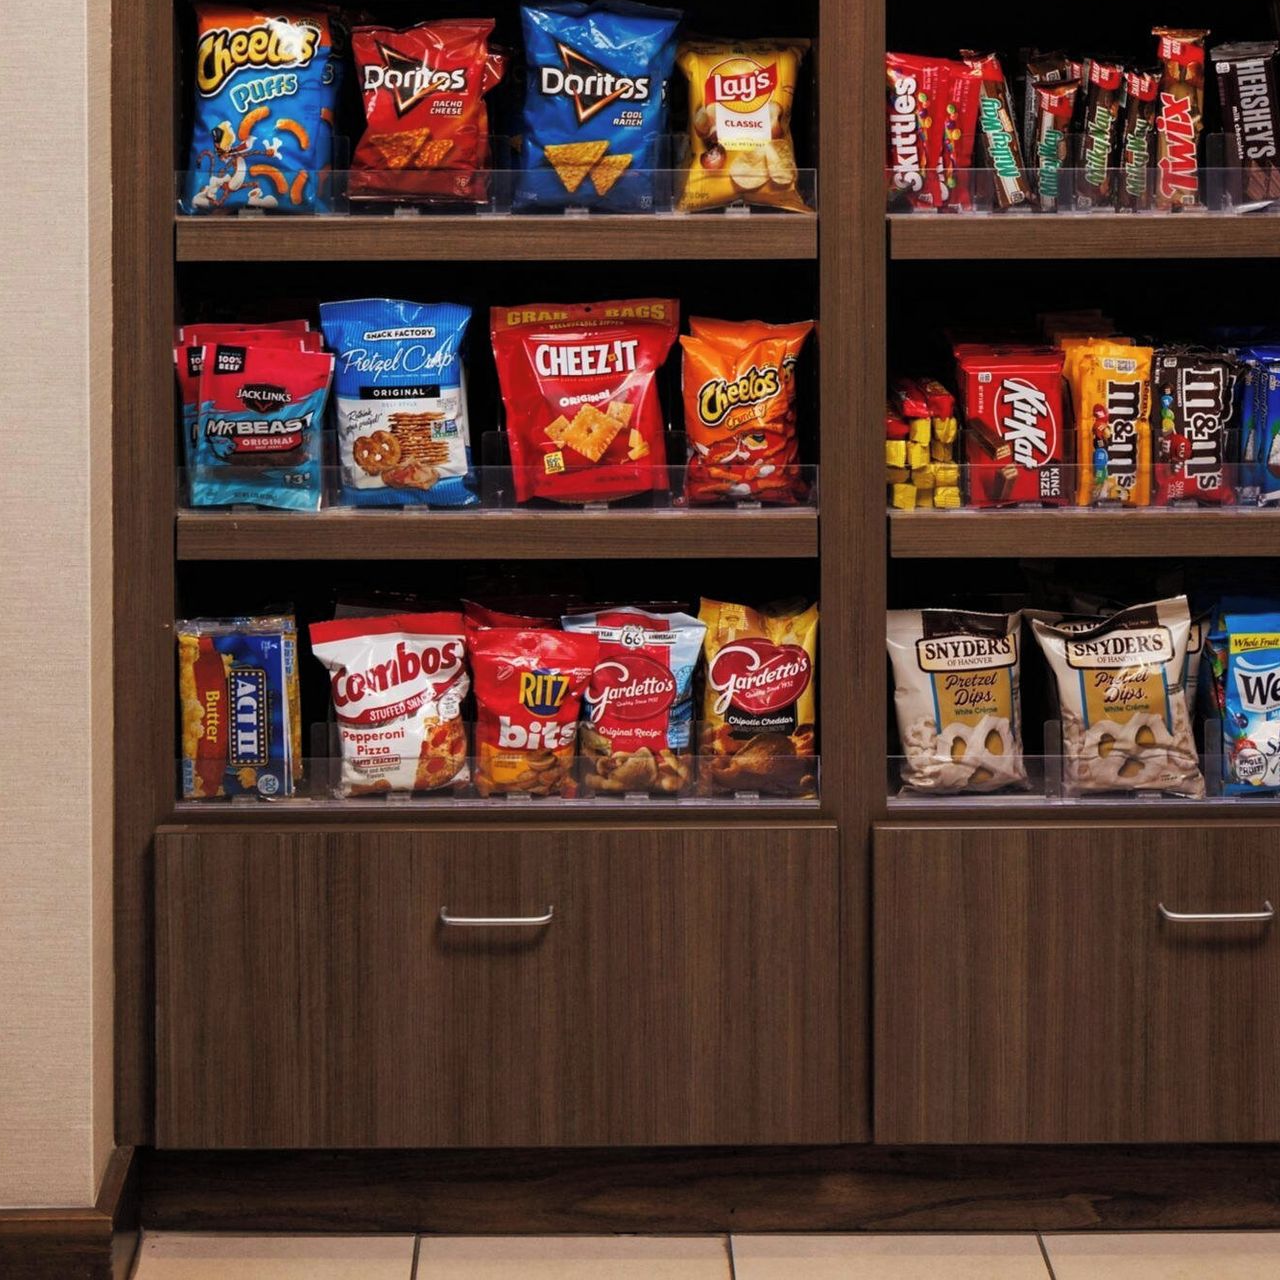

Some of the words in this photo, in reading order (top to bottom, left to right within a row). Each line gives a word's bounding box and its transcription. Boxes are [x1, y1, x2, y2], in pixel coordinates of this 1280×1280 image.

[364, 63, 466, 92] Doritos
[541, 67, 649, 100] Doritos
[714, 70, 771, 102] Lay's
[232, 73, 298, 111] PUFFS
[429, 107, 463, 115] CHEESE
[433, 100, 463, 108] NACHO
[621, 111, 643, 119] COOL
[1237, 57, 1277, 161] HERSHEY'S
[612, 118, 644, 126] RANCH
[724, 119, 764, 129] CLASSIC
[891, 73, 924, 192] Skittles
[988, 131, 1020, 178] Milky
[1157, 92, 1199, 199] Twix
[507, 311, 568, 326] GRAB
[605, 304, 665, 320] BAGS
[218, 355, 242, 365] 100%
[218, 363, 240, 371] BEEF
[373, 387, 425, 397] ORIGINAL
[699, 367, 780, 424] Cheetos
[242, 437, 294, 447] ORIGINAL
[1040, 471, 1050, 496] SIZE
[1050, 467, 1060, 496] KING
[925, 637, 1012, 660] SNYDER'S
[1073, 634, 1164, 657] SNYDER'S
[956, 656, 993, 667] HANOVER
[331, 641, 458, 707] Combos
[708, 646, 808, 715] Gardetto's
[945, 671, 997, 690] Pretzel
[1094, 670, 1149, 690] Pretzel
[519, 671, 570, 708] RITZ
[585, 661, 673, 723] Gardetto's
[206, 690, 220, 743] Butter
[370, 702, 405, 722] STUFFED
[342, 726, 405, 744] Pepperoni
[499, 716, 576, 749] bits
[599, 726, 632, 737] Original
[357, 744, 390, 756] Pizza
